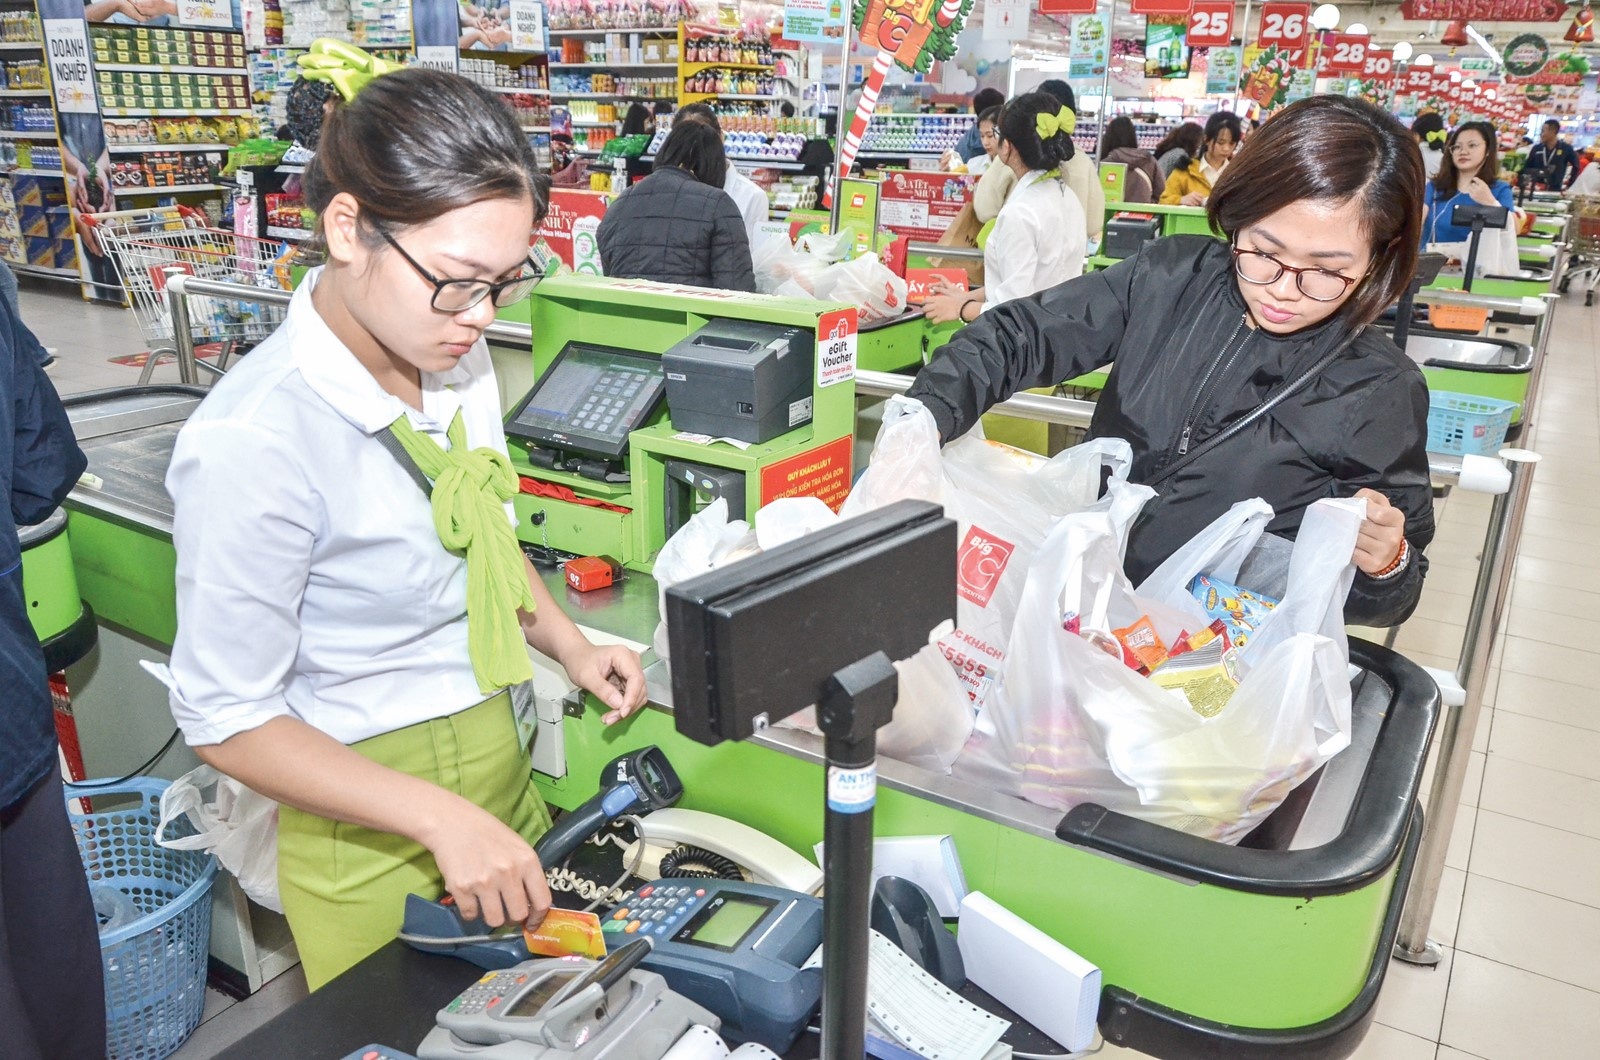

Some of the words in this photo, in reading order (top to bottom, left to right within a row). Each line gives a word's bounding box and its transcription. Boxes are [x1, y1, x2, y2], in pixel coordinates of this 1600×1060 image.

[883, 8, 901, 25] Big
[1190, 12, 1229, 36] 25
[878, 14, 914, 53] C
[1262, 13, 1304, 39] 26
[51, 38, 85, 57] DOANH
[1332, 43, 1365, 63] 28
[55, 59, 87, 85] NGHIỆP
[1314, 55, 1330, 72] 2
[1364, 57, 1391, 74] 30
[1407, 71, 1431, 86] 32
[1430, 80, 1450, 92] 34
[1449, 87, 1460, 97] 6
[547, 201, 560, 217] ẾT
[828, 341, 848, 355] eGift
[822, 352, 853, 369] Voucher
[787, 469, 799, 482] QUÝ
[799, 462, 818, 477] KHÁCH
[811, 476, 822, 488] TRA
[821, 469, 833, 483] HÓA
[830, 480, 842, 491] HÓA
[836, 488, 849, 501] TOÁN
[969, 535, 994, 556] Big
[960, 542, 1010, 591] C
[963, 634, 1002, 660] KHÁCH
